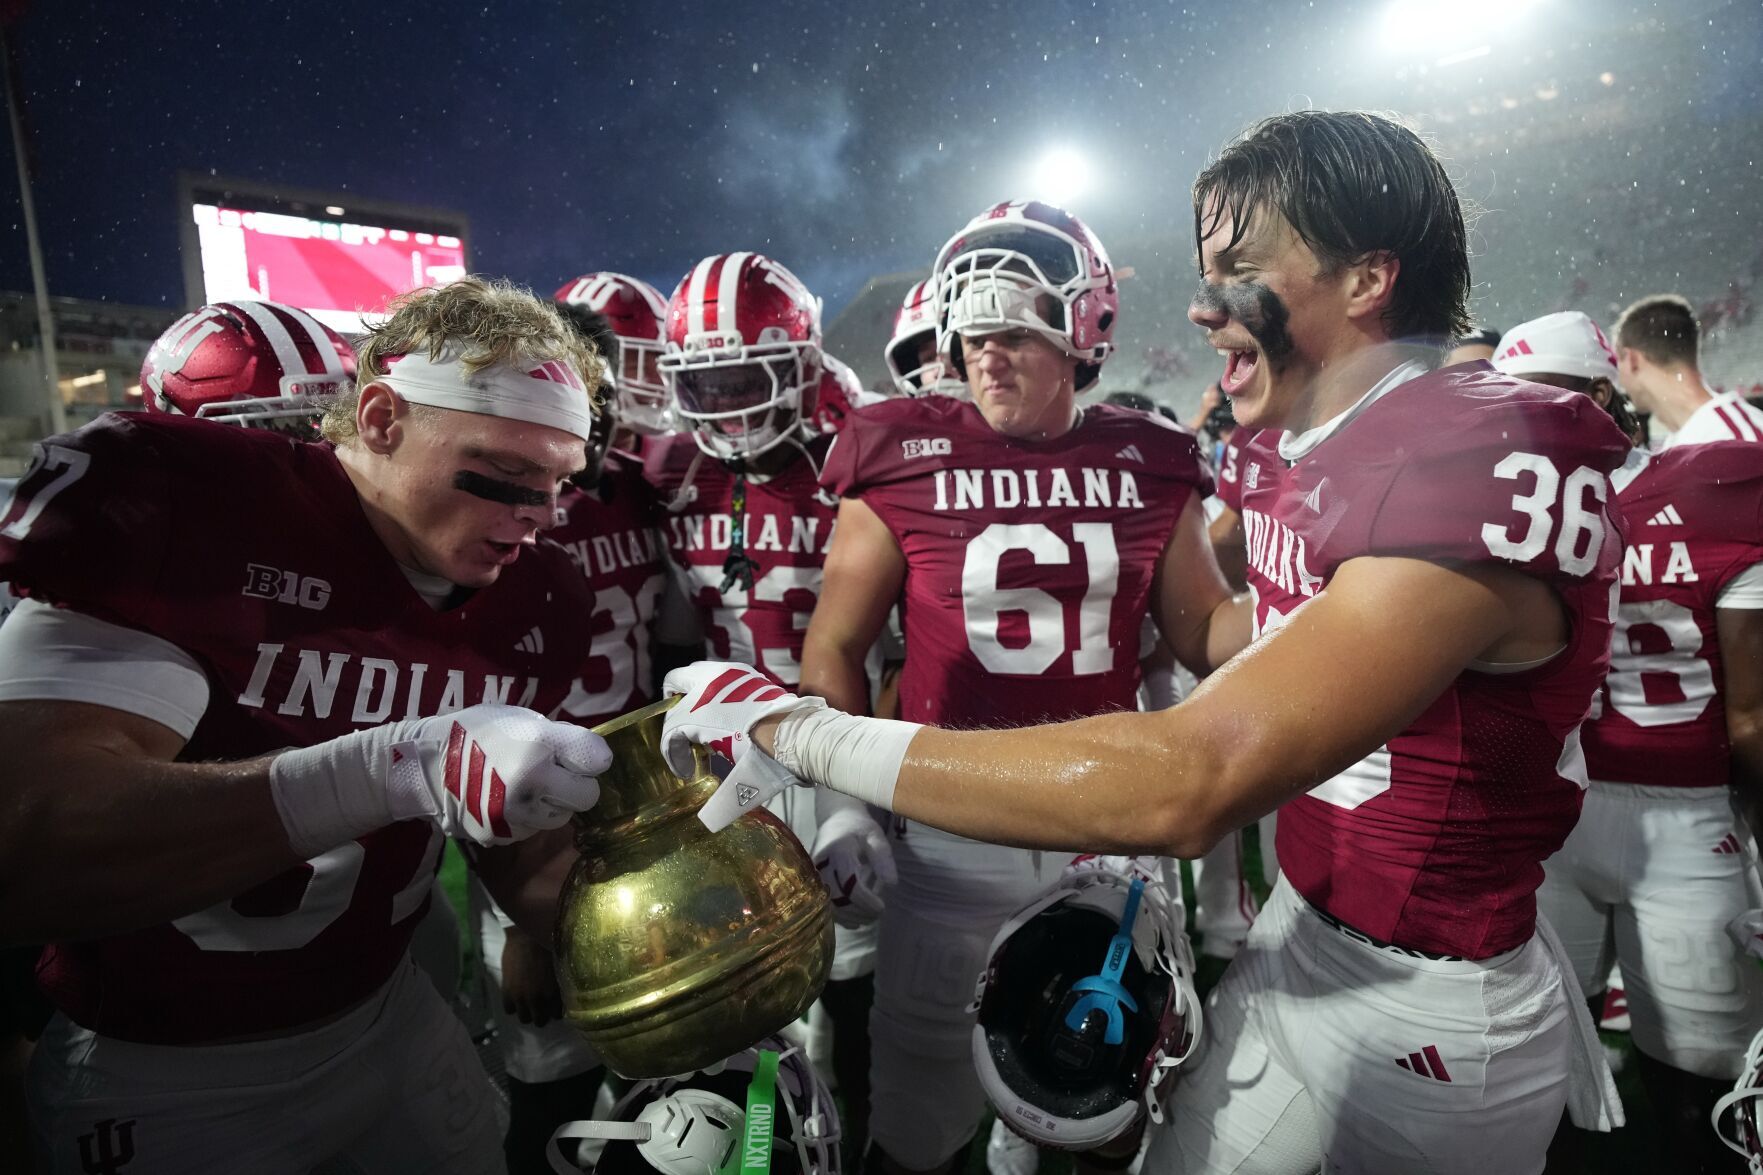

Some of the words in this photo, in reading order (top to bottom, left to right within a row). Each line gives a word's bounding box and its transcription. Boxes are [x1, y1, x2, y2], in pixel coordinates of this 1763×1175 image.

[933, 468, 1145, 511] INDIANA
[1481, 451, 1607, 577] 36
[962, 522, 1120, 675] 61
[745, 1103, 772, 1168] NXTRND
